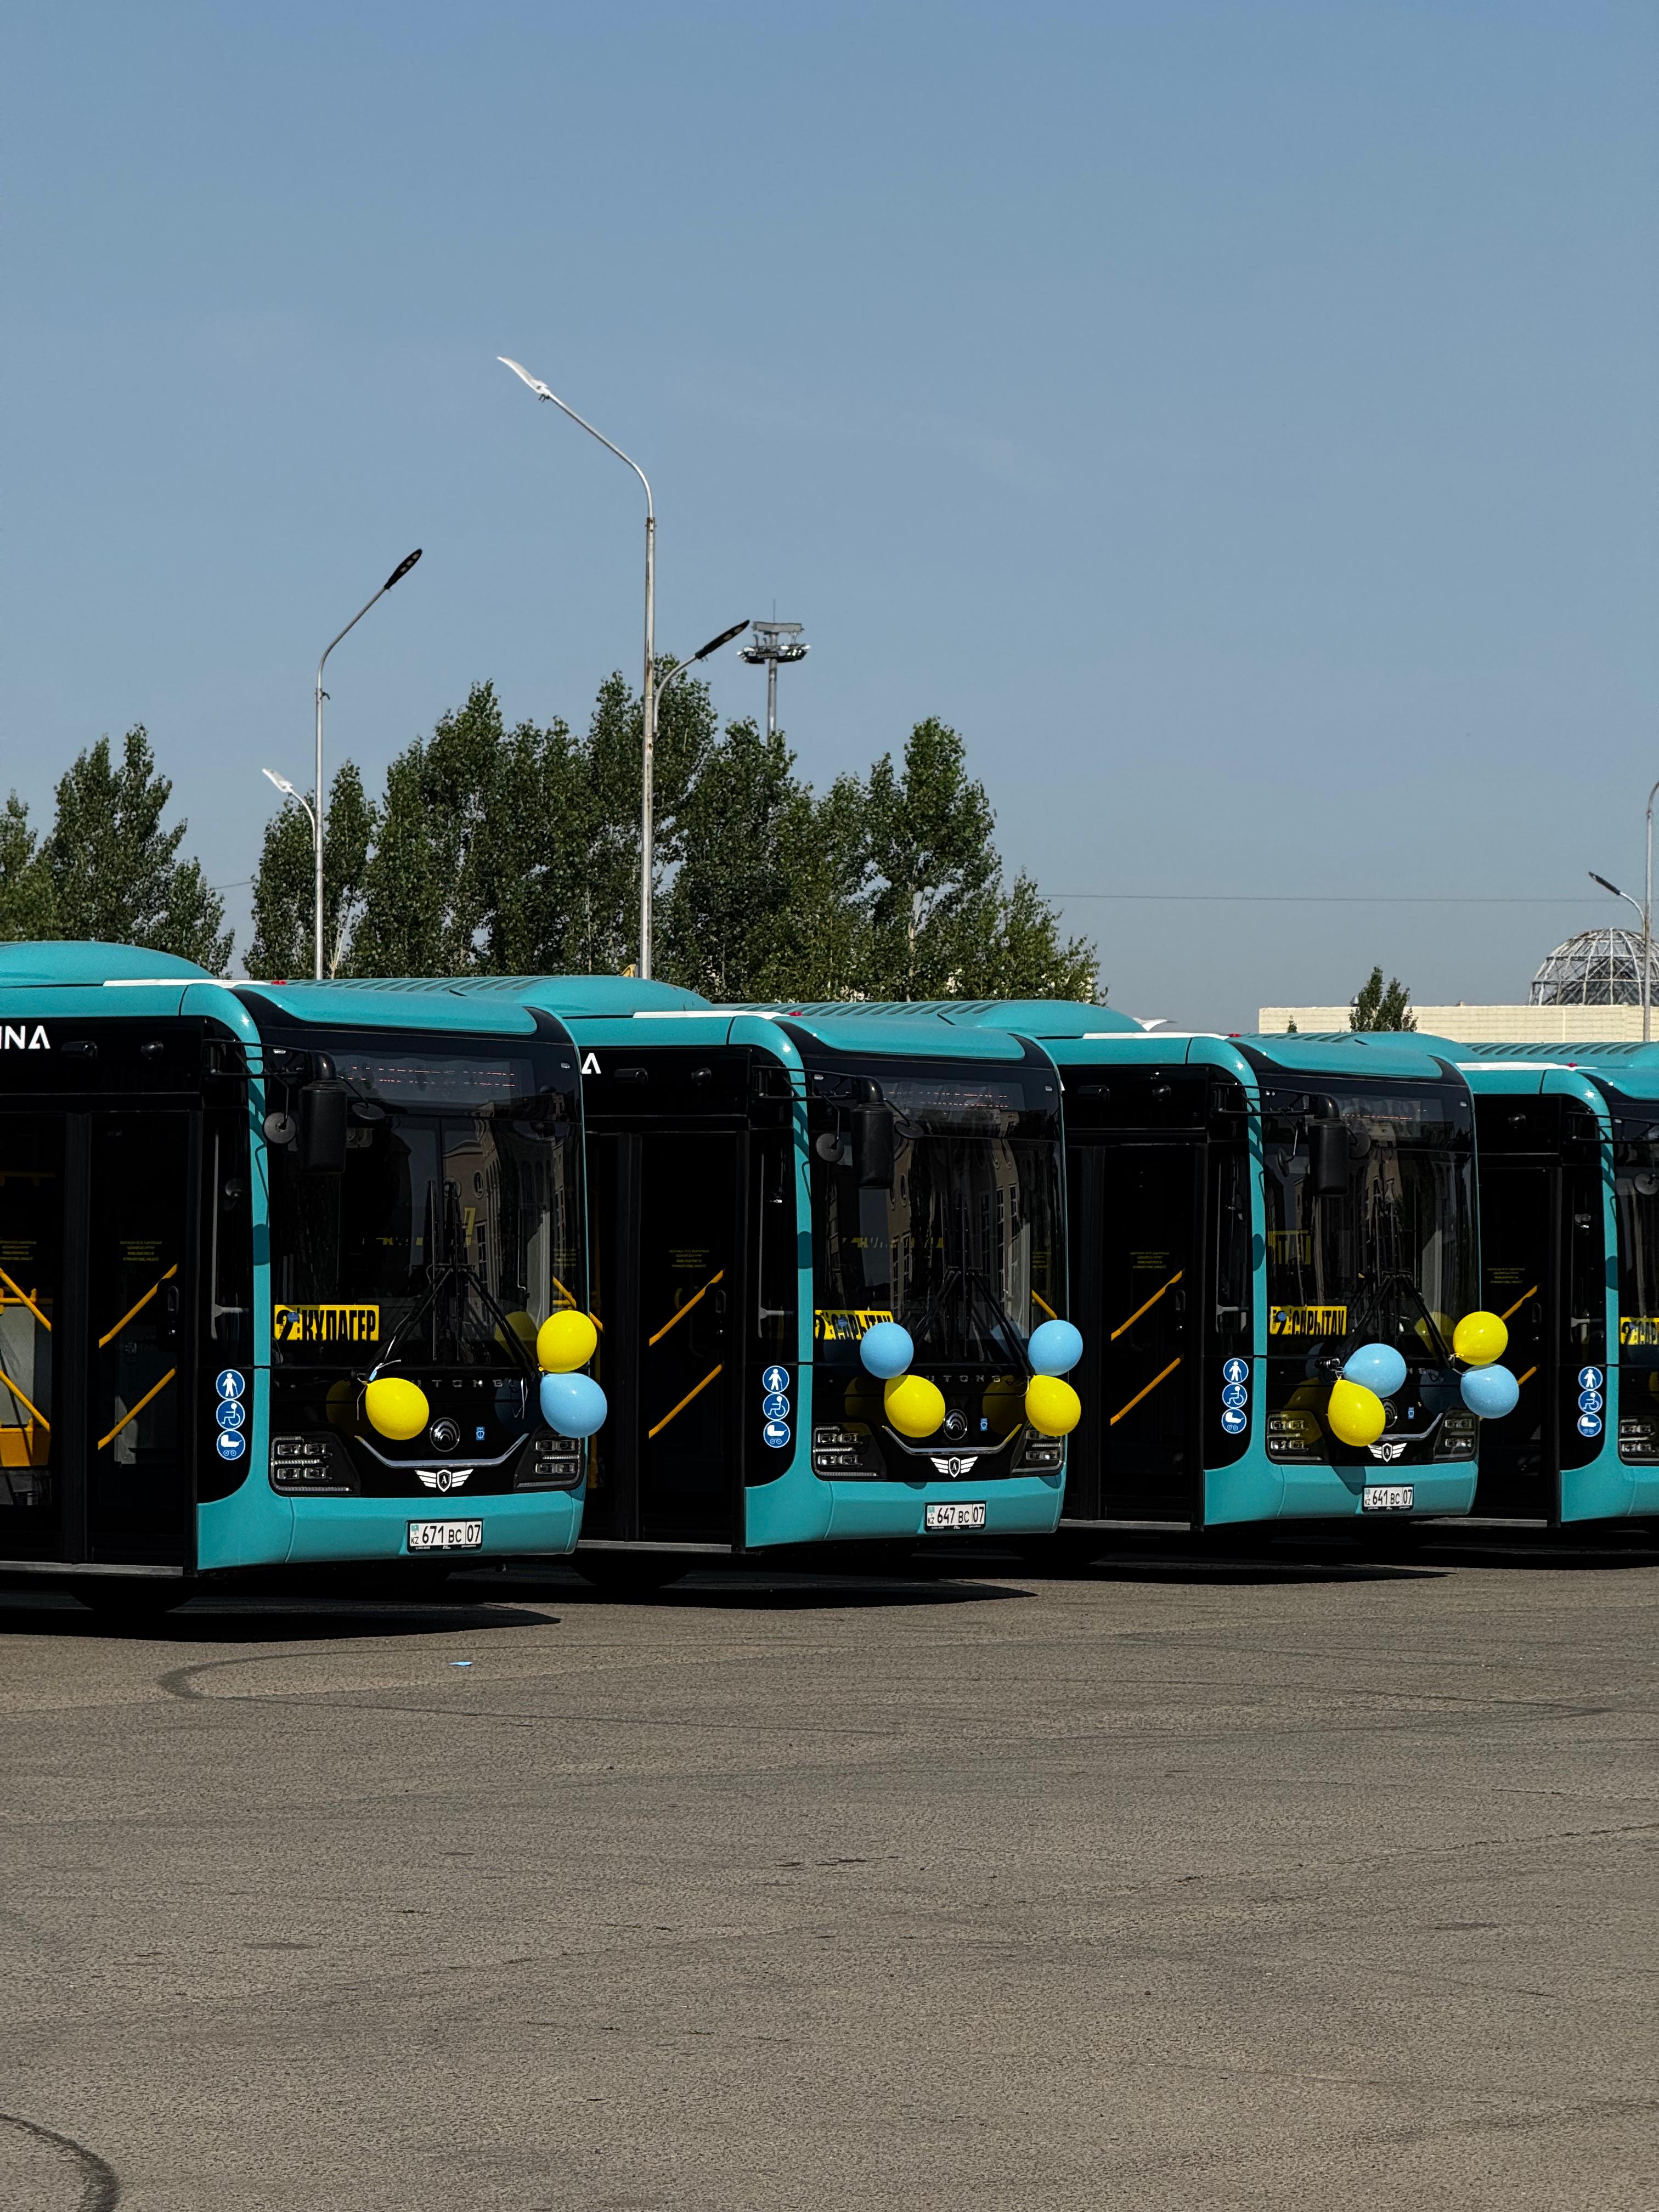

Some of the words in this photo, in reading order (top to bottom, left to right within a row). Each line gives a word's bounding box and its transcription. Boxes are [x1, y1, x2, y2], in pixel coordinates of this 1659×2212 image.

[1372, 1489, 1389, 1505] 641
[1390, 1493, 1400, 1505] BC
[1403, 1489, 1412, 1504] 07
[937, 1507, 956, 1524] 647
[958, 1510, 970, 1523] BC
[973, 1506, 984, 1523] 07
[411, 1536, 419, 1544] KZ
[422, 1525, 444, 1544] 671
[448, 1528, 462, 1543] BC
[467, 1524, 481, 1543] 07
